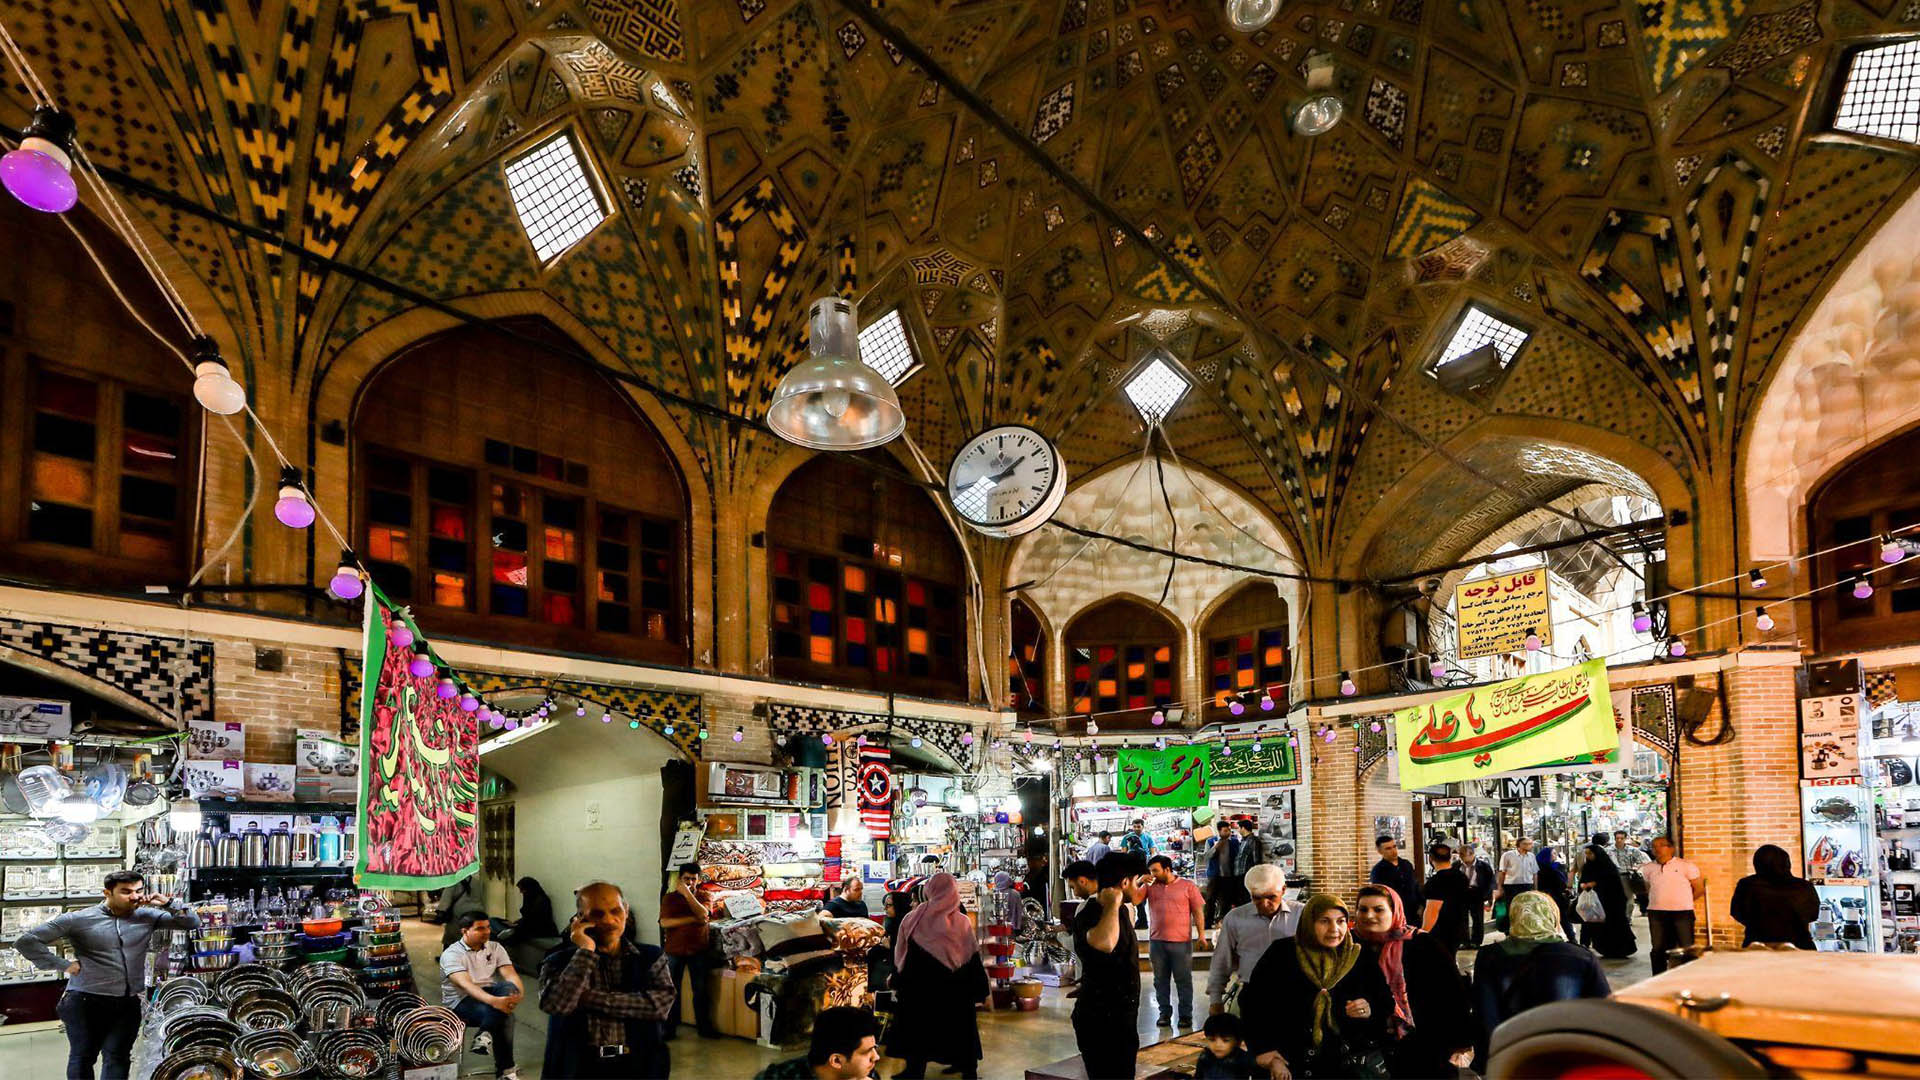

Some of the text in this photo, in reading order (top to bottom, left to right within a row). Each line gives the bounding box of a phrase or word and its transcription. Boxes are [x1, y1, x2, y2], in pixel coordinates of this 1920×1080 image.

[1464, 573, 1536, 598] قابل توجه
[1477, 609, 1495, 617] محترم
[1409, 693, 1592, 766] علی
[1126, 755, 1201, 801] مهدی
[1810, 776, 1856, 787] Tefal
